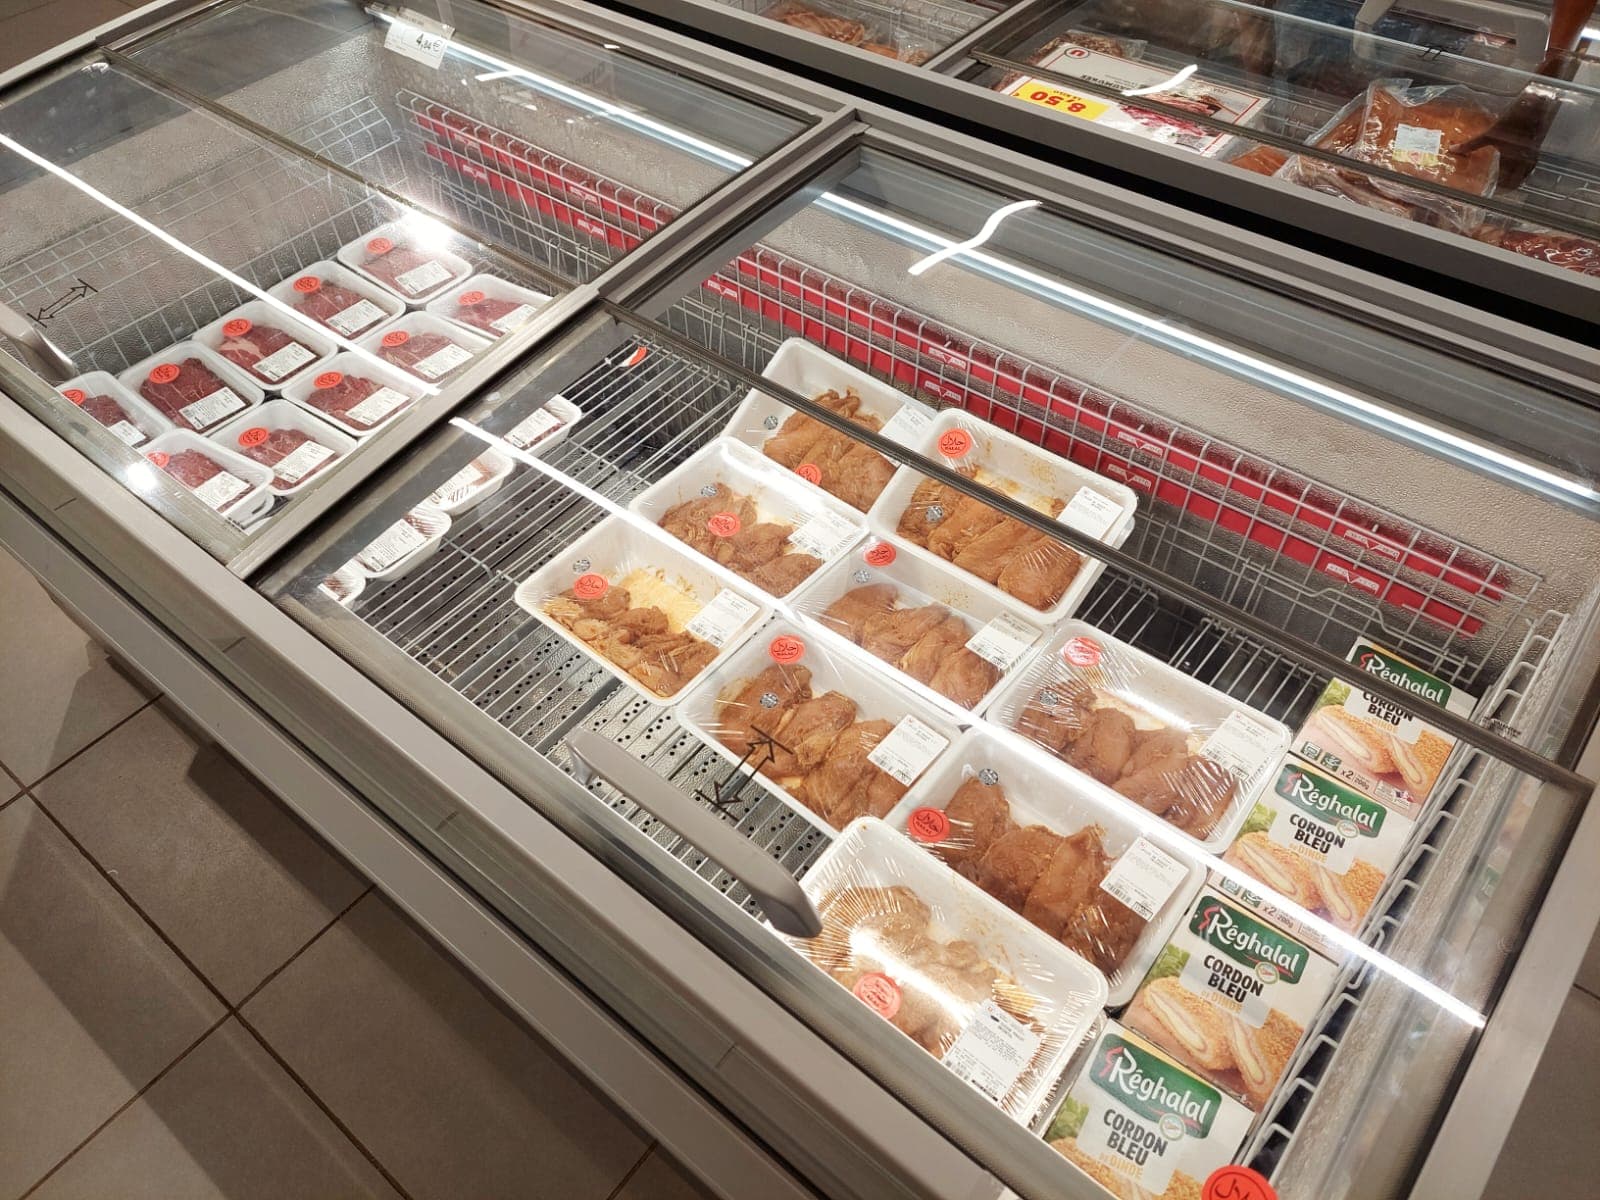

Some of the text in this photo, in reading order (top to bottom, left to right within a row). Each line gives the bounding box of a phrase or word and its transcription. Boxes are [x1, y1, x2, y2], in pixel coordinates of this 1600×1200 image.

[1030, 91, 1086, 112] 8,50
[1367, 703, 1401, 727] BLEU
[1291, 773, 1378, 830] Réghalal
[1289, 813, 1346, 849] CORDON
[1293, 828, 1332, 855] BLEU
[1208, 907, 1299, 972] Réghalal
[1203, 955, 1264, 997] CORDON
[1207, 973, 1247, 1004] BLEU
[1109, 1047, 1211, 1125] Réghalal
[1103, 1108, 1168, 1157] CORDON
[1106, 1131, 1149, 1167] BLEU
